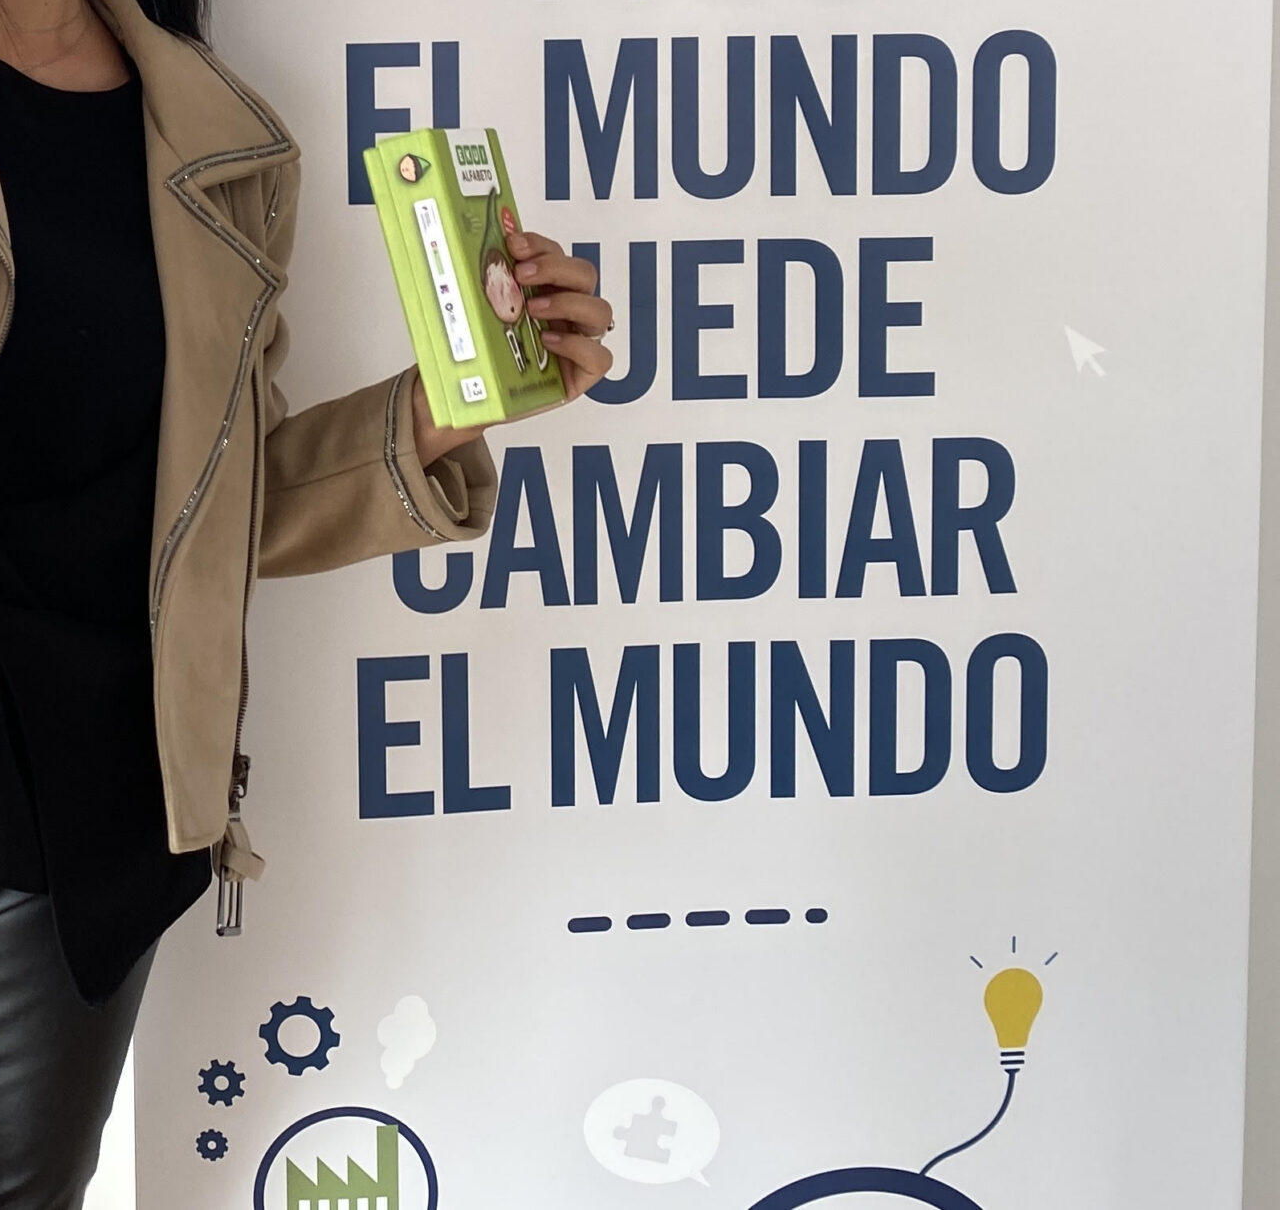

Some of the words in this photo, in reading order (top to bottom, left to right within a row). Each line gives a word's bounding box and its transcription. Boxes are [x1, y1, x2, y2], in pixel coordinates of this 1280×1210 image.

[462, 169, 493, 183] ALFABETO
[543, 29, 1057, 201] MUNDO
[571, 237, 935, 404] UEDE
[357, 653, 512, 819] EL
[550, 632, 1049, 808] MUNDO
